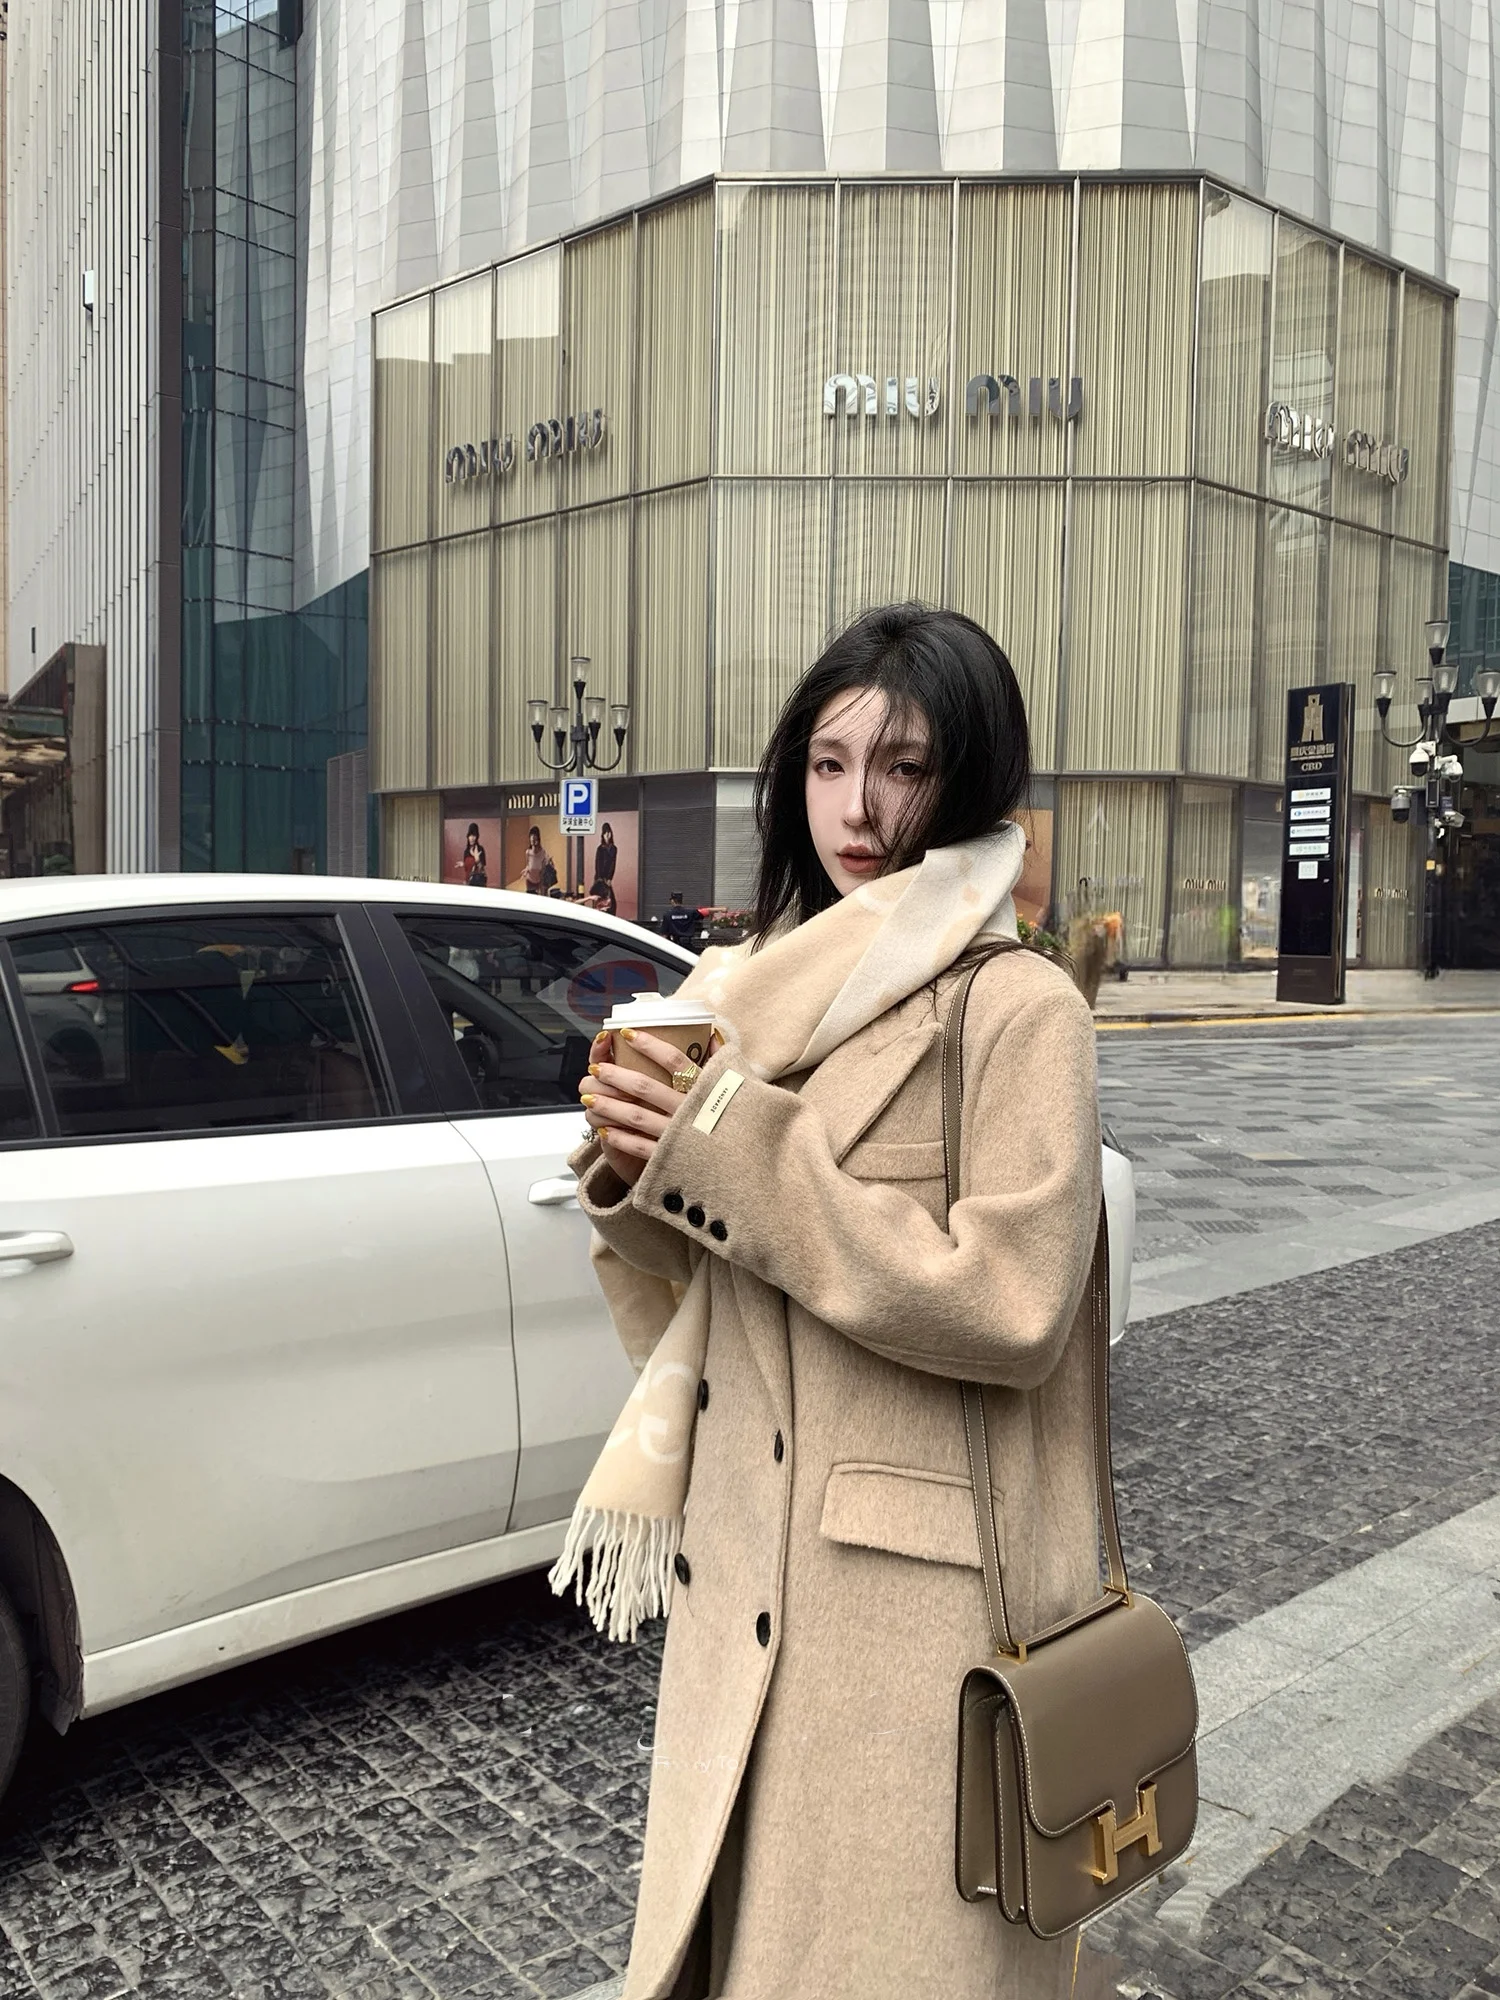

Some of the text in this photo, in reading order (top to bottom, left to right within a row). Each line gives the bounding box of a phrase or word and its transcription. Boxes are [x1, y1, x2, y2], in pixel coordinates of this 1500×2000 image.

[1301, 762, 1323, 772] CBD
[568, 783, 589, 814] P
[710, 1087, 729, 1113] HANDMADE
